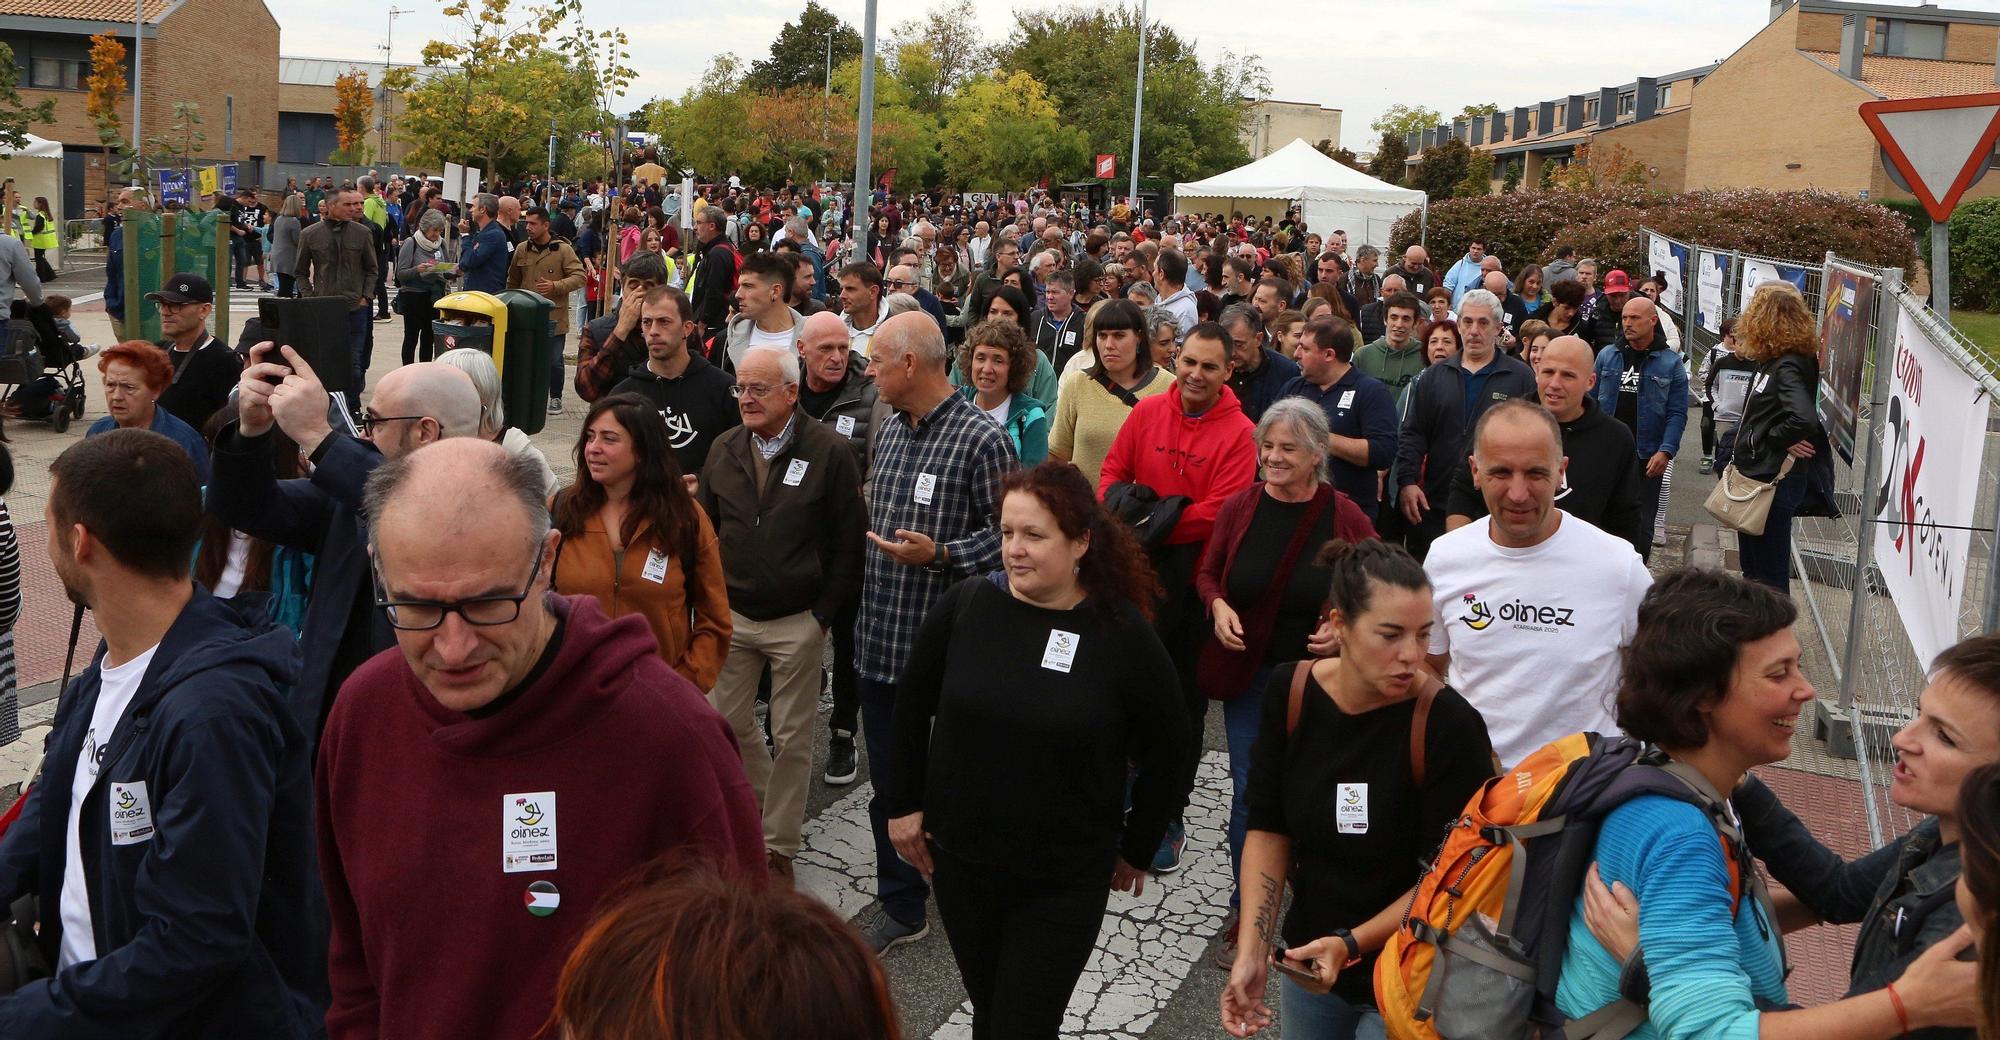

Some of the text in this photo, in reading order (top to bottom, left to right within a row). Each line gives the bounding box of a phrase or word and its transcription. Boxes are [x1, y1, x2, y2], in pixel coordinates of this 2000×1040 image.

[1498, 598, 1575, 627] oinez
[1512, 623, 1560, 634] ATARRABIA 2025
[115, 807, 145, 819] oinez
[1340, 804, 1364, 813] oinez
[510, 825, 550, 839] oinez
